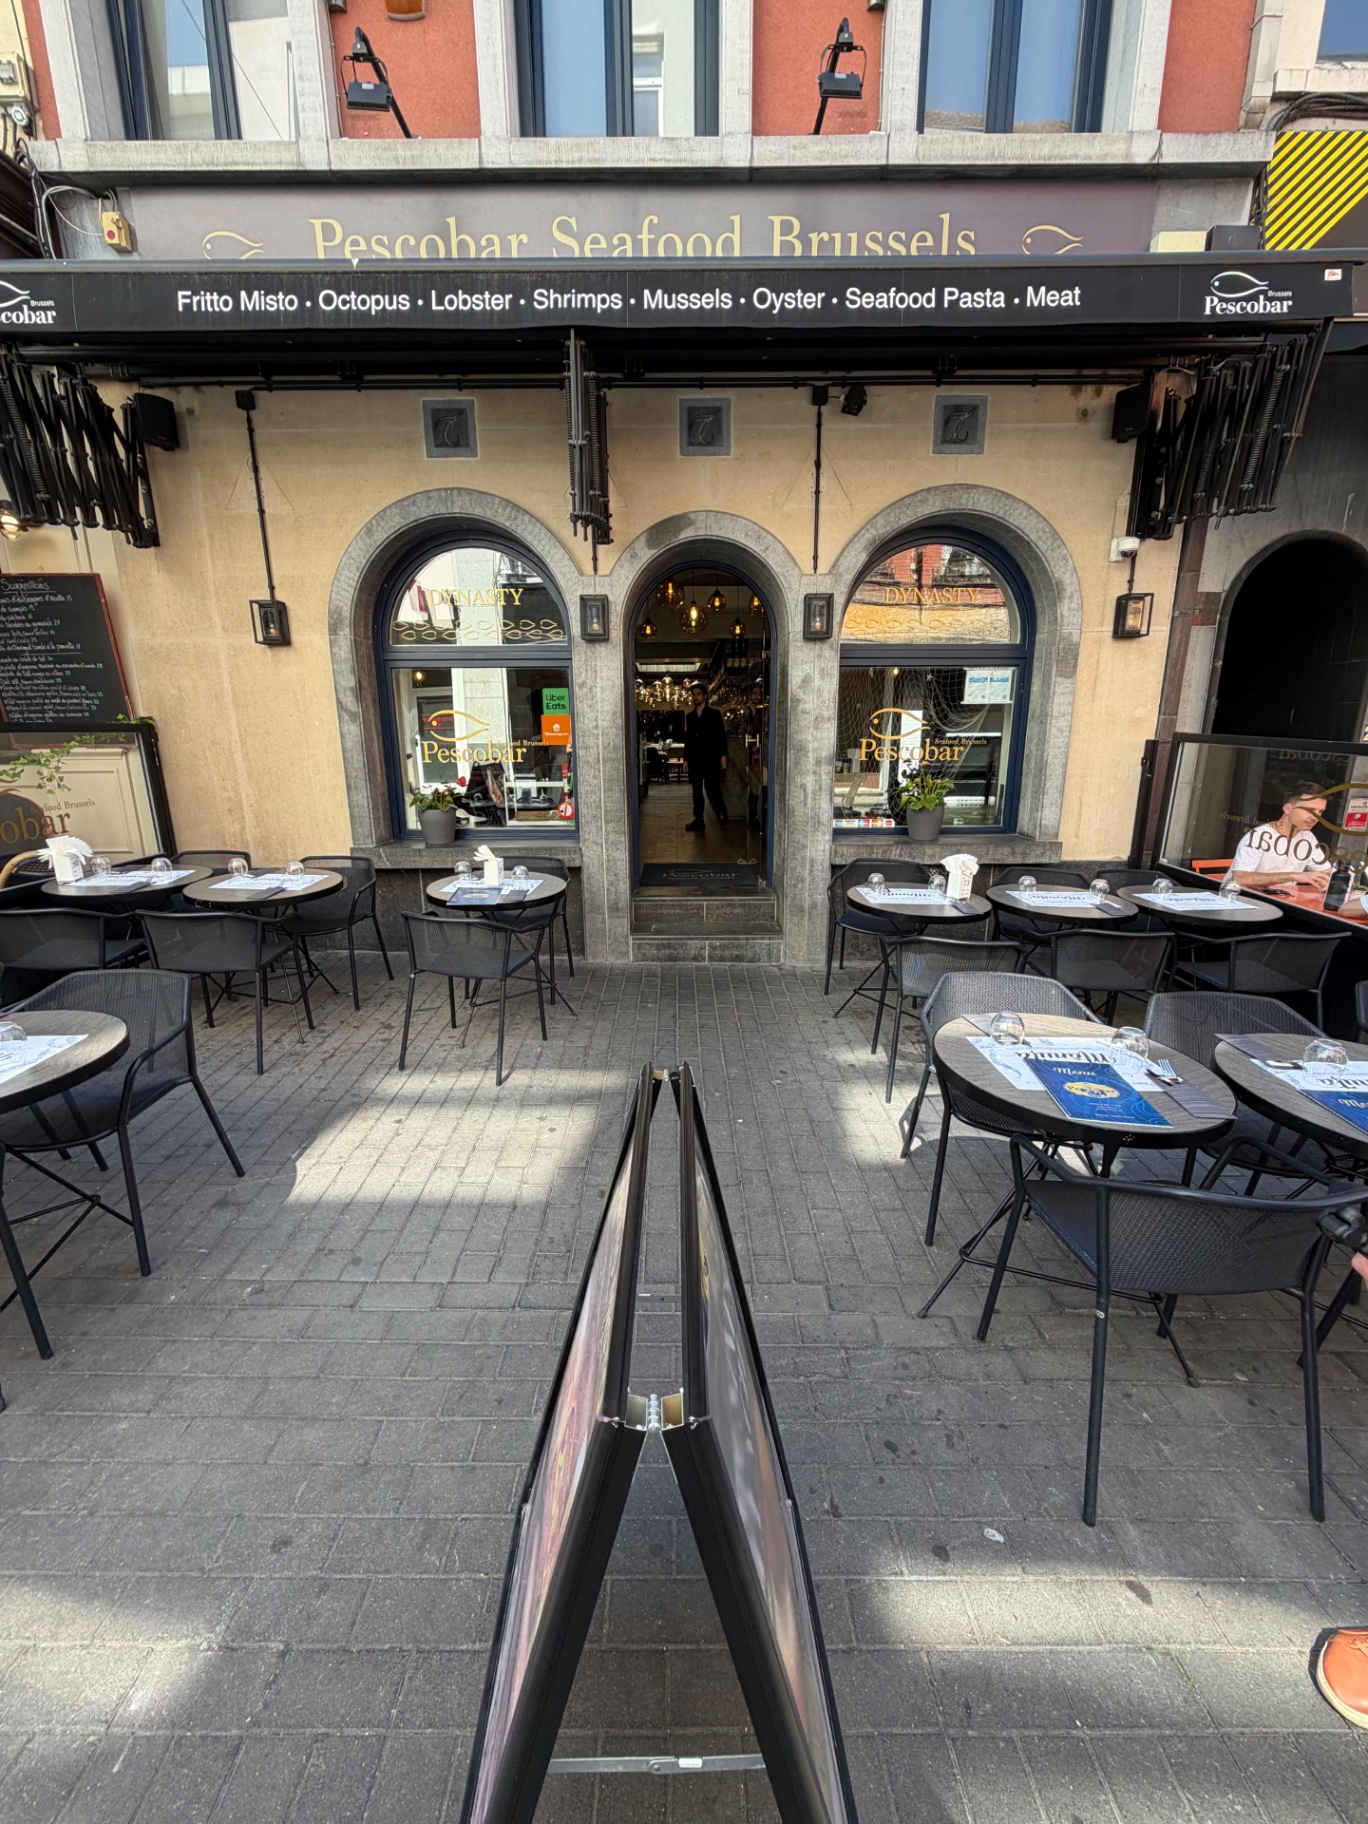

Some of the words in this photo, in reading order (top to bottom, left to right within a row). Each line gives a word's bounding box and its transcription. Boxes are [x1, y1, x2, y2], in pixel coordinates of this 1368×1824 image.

[309, 216, 528, 258] Pescobar
[551, 214, 740, 258] Seafood
[768, 212, 976, 257] Brussels
[30, 299, 55, 307] Brussels
[177, 290, 233, 313] Fritto
[240, 290, 299, 312] Misto
[318, 289, 411, 316] Octopus
[431, 289, 513, 311] Lobster
[533, 288, 623, 314] Shrimps
[643, 287, 733, 310] Mussels
[752, 287, 826, 314] Oyster
[845, 287, 936, 309] Seafood
[943, 287, 1006, 309] Pasta
[1026, 285, 1081, 307] Meat
[1203, 295, 1293, 315] Pescobar
[0, 304, 56, 324] cobar
[427, 588, 523, 606] DYNASTY
[884, 587, 980, 605] DYNASTY
[545, 693, 566, 702] Uber
[546, 702, 567, 710] Eats
[421, 740, 527, 764] Pescobar
[858, 738, 965, 762] Pescobar
[64, 798, 96, 810] Brussels
[1053, 1067, 1097, 1077] Menu
